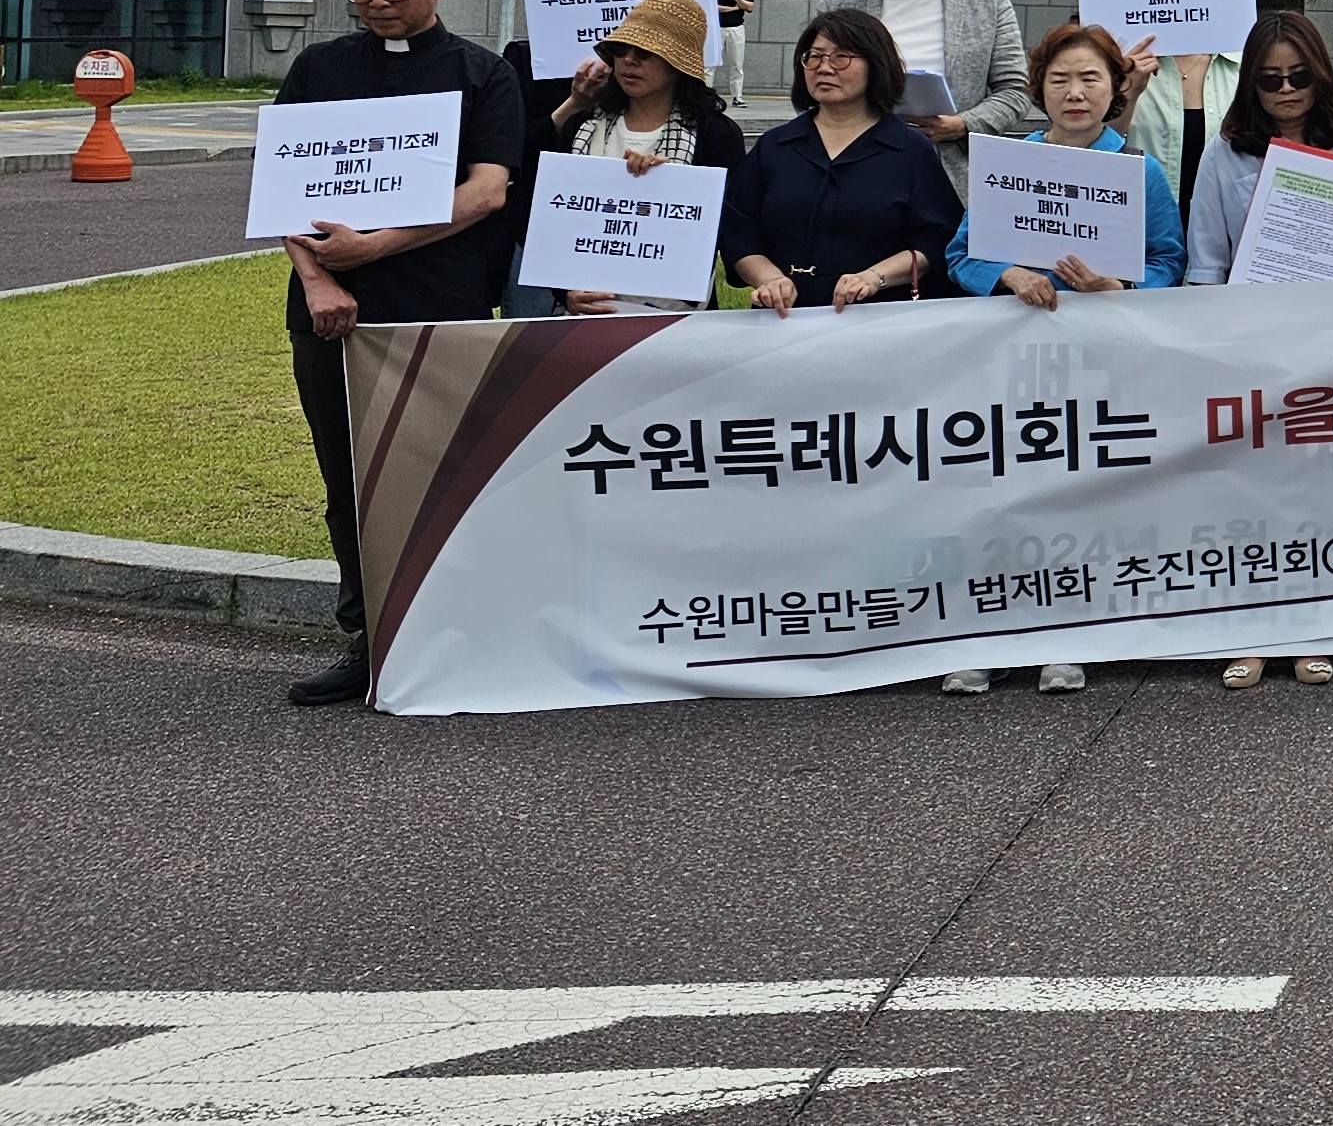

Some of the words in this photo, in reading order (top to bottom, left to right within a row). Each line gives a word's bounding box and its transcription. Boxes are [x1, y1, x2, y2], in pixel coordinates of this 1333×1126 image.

[1126, 8, 1208, 24] 반대합니다!
[275, 132, 438, 161] 수원마을만들기조례
[335, 158, 371, 175] 폐지
[306, 176, 401, 197] 반대합니다!
[985, 174, 1127, 207] 수원마을만들기조례
[550, 194, 702, 222] 수원마을만들기조례
[1038, 200, 1068, 217] 폐지
[603, 220, 637, 236] 폐지
[1015, 216, 1097, 240] 반대합니다!
[575, 238, 664, 259] 반대합니다!
[564, 400, 1156, 494] 수원특례시의회는
[639, 582, 952, 649] 수원마을만들기
[968, 564, 1096, 613] 법제화
